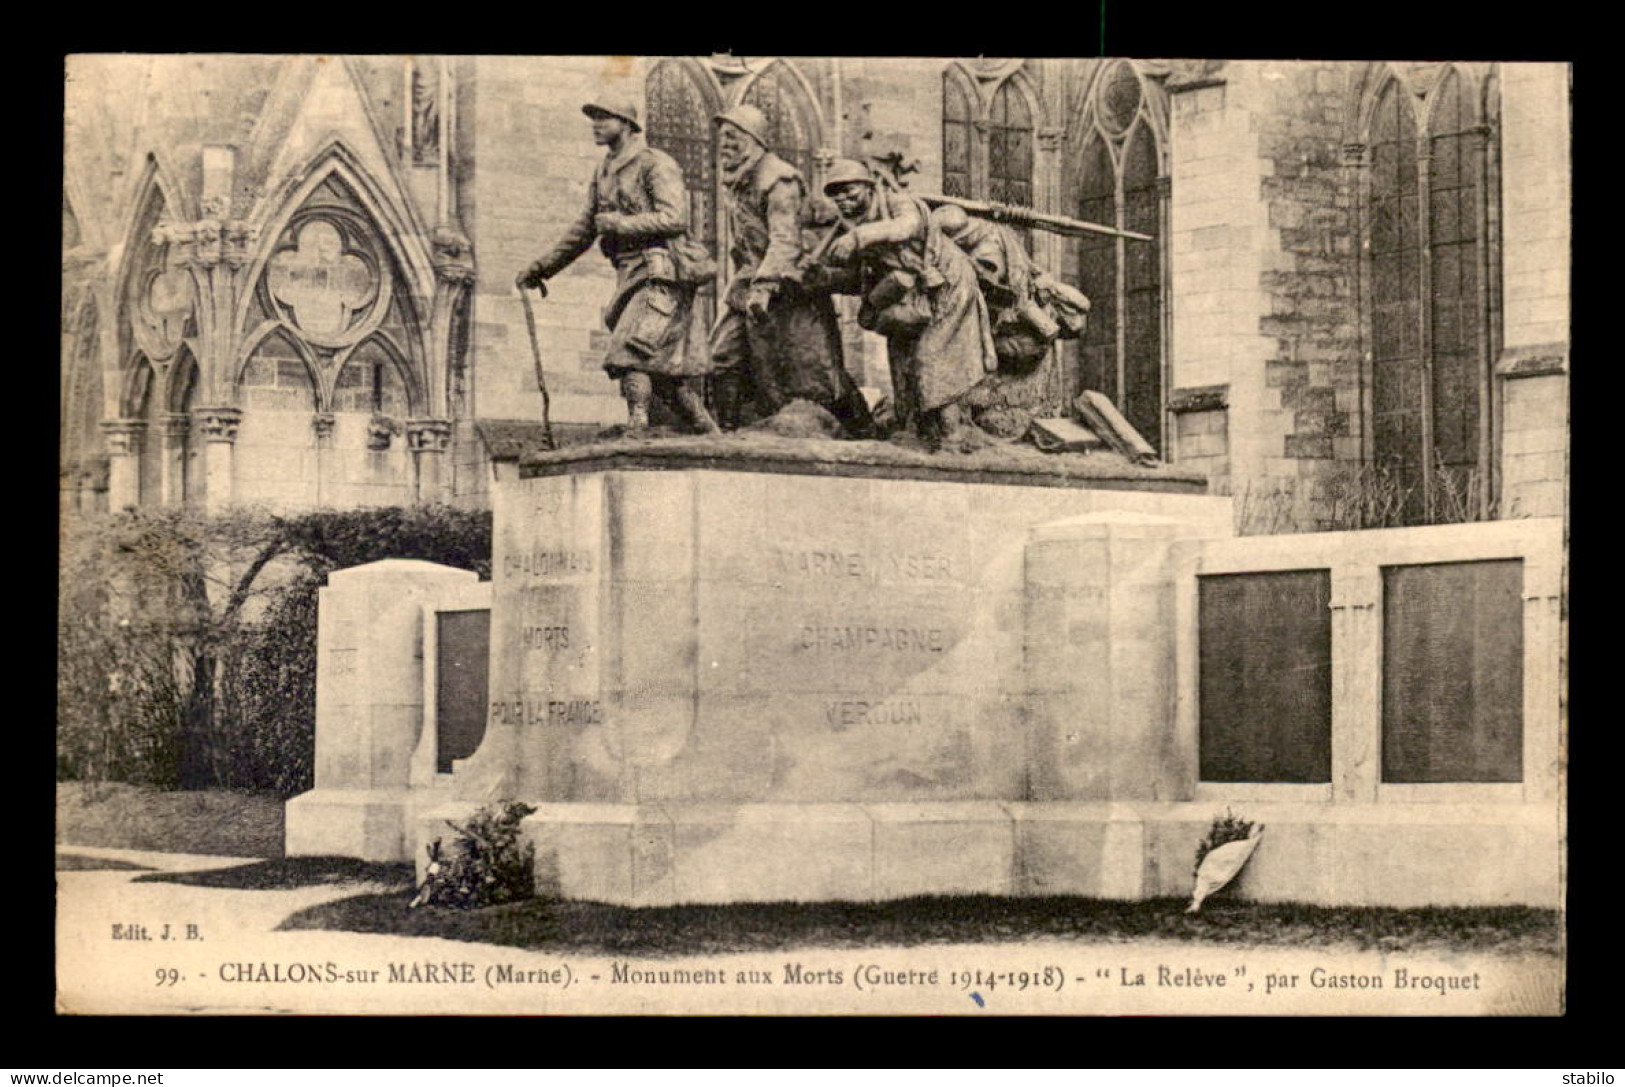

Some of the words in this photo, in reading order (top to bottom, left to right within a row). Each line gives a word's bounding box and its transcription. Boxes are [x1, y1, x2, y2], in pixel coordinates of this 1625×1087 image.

[523, 626, 570, 650] MORTS
[801, 626, 943, 653] CHAMPAGNE
[548, 700, 602, 726] FRANCE
